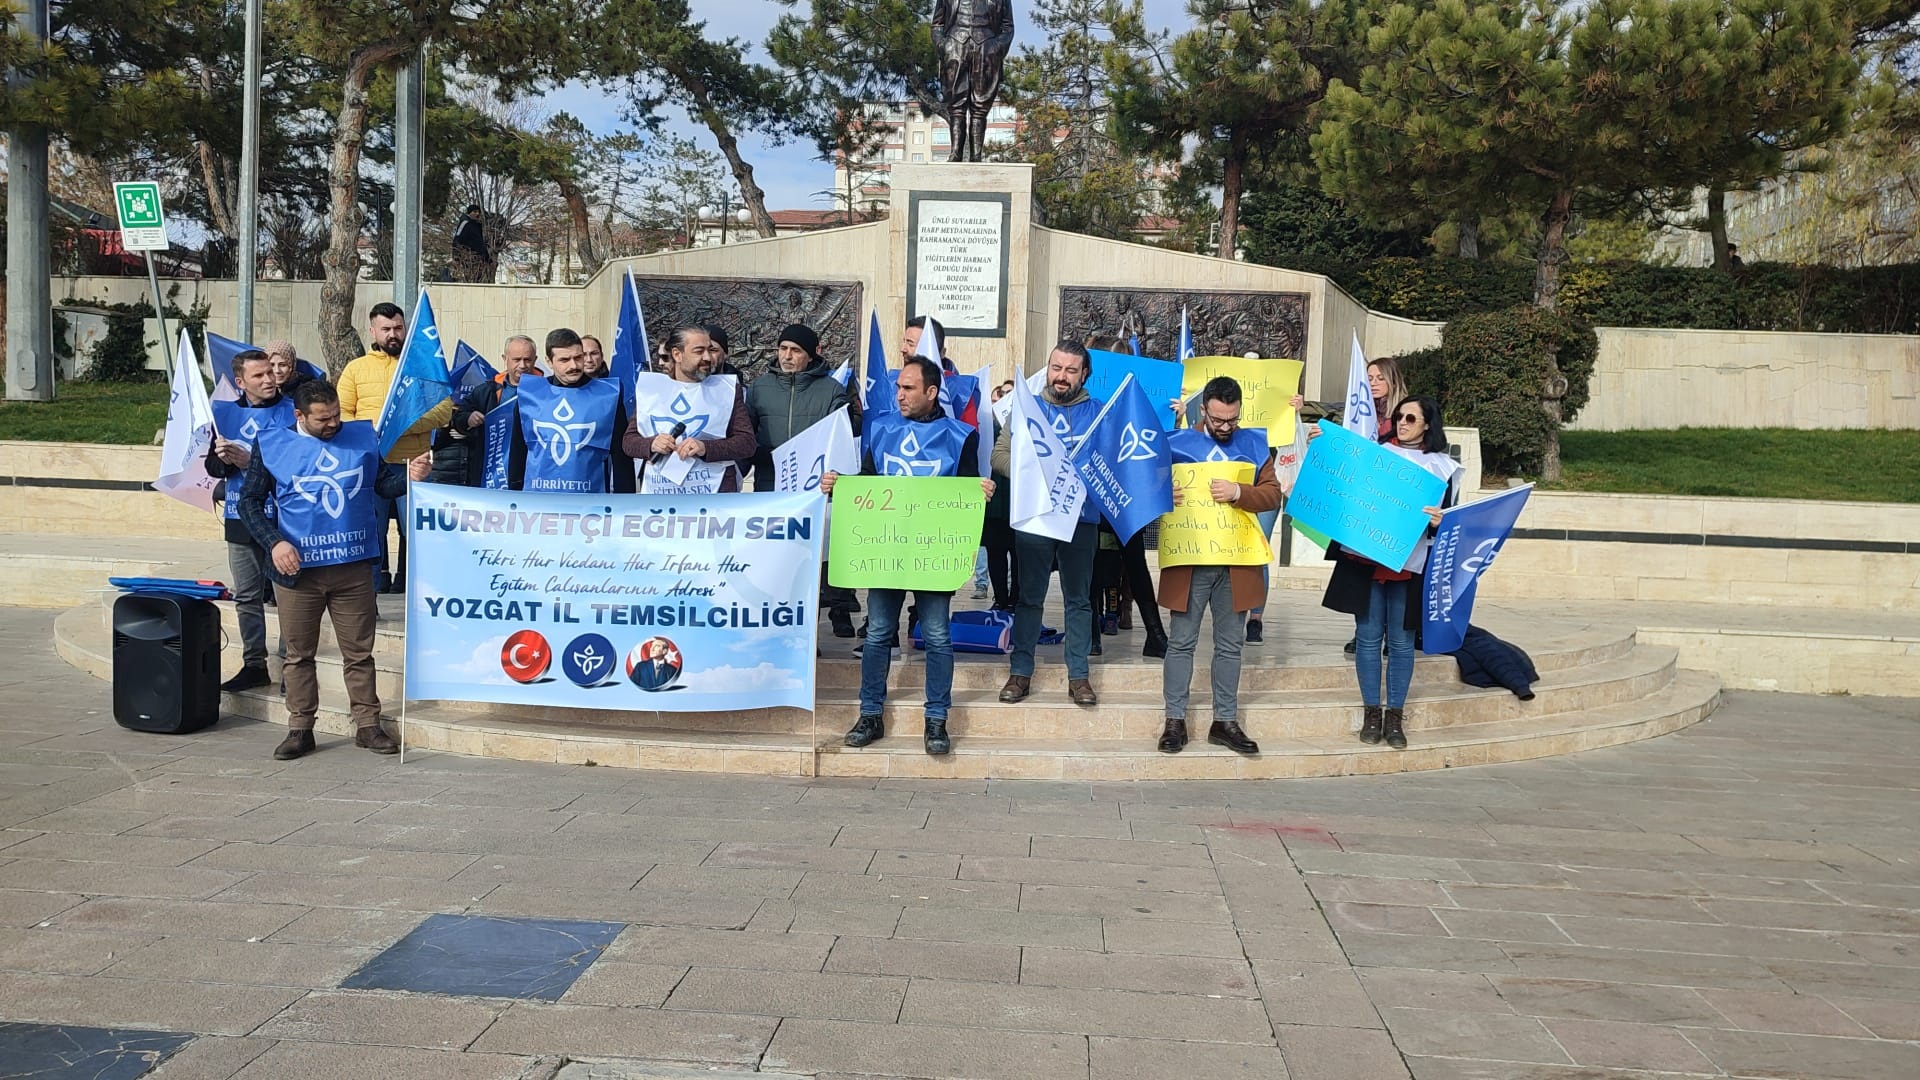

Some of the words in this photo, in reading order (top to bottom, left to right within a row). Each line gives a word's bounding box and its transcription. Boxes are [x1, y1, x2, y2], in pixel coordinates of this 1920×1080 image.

[950, 244, 968, 253] TÜRK
[1091, 450, 1133, 508] HÜRRİYETÇİ
[1081, 463, 1120, 519] EĞİTİM-SEN
[928, 493, 982, 510] cevaben
[416, 502, 612, 544] HÜRRİYETÇİ
[622, 507, 736, 540] EĞİTİM
[745, 516, 811, 540] SEN
[300, 528, 366, 547] HÜRRİYETÇİ
[852, 523, 908, 545] Sendika
[304, 544, 364, 562] EĞİTİM-SEN
[850, 558, 905, 573] SATILIK
[424, 597, 542, 622] YOZGAT
[553, 596, 580, 623] İL
[590, 600, 804, 628] TEMSİLCİLİĞİ
